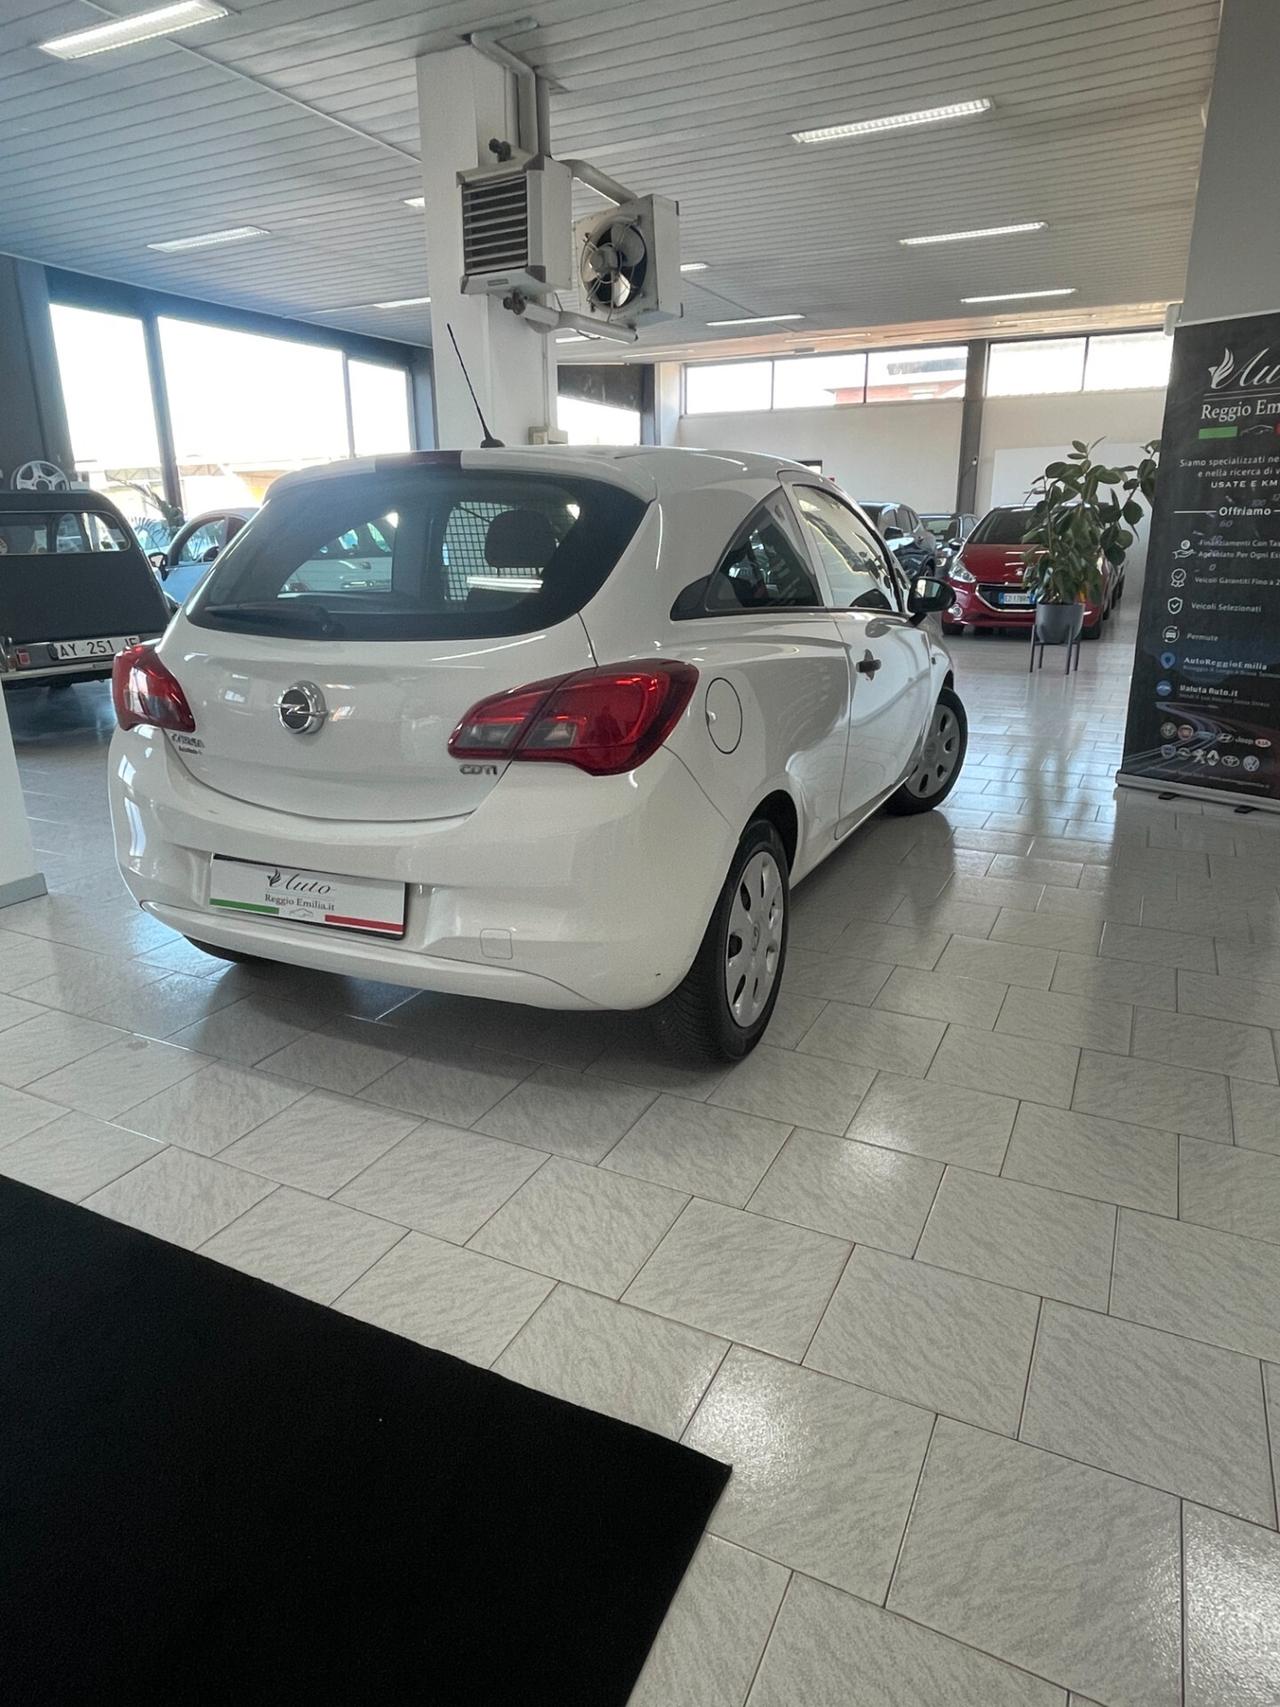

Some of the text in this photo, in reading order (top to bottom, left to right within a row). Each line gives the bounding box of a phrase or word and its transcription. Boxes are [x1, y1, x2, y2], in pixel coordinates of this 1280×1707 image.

[1201, 401, 1252, 422] Reggio
[1180, 458, 1207, 468] Siamo
[1208, 456, 1265, 467] specializzati
[1198, 470, 1203, 478] e
[1205, 468, 1227, 477] nella
[1230, 468, 1261, 477] ricerca
[1263, 466, 1273, 475] di
[1210, 479, 1278, 488] USATE E KM
[1218, 506, 1272, 516] Offriamo
[1249, 551, 1269, 560] Ogni
[1191, 602, 1262, 612] Veicoli Selezionati
[1187, 632, 1219, 641] Permute
[60, 643, 78, 657] AY
[86, 640, 115, 655] 251
[460, 764, 497, 775] CDTI
[265, 893, 335, 911] Reggio Emilia.it
